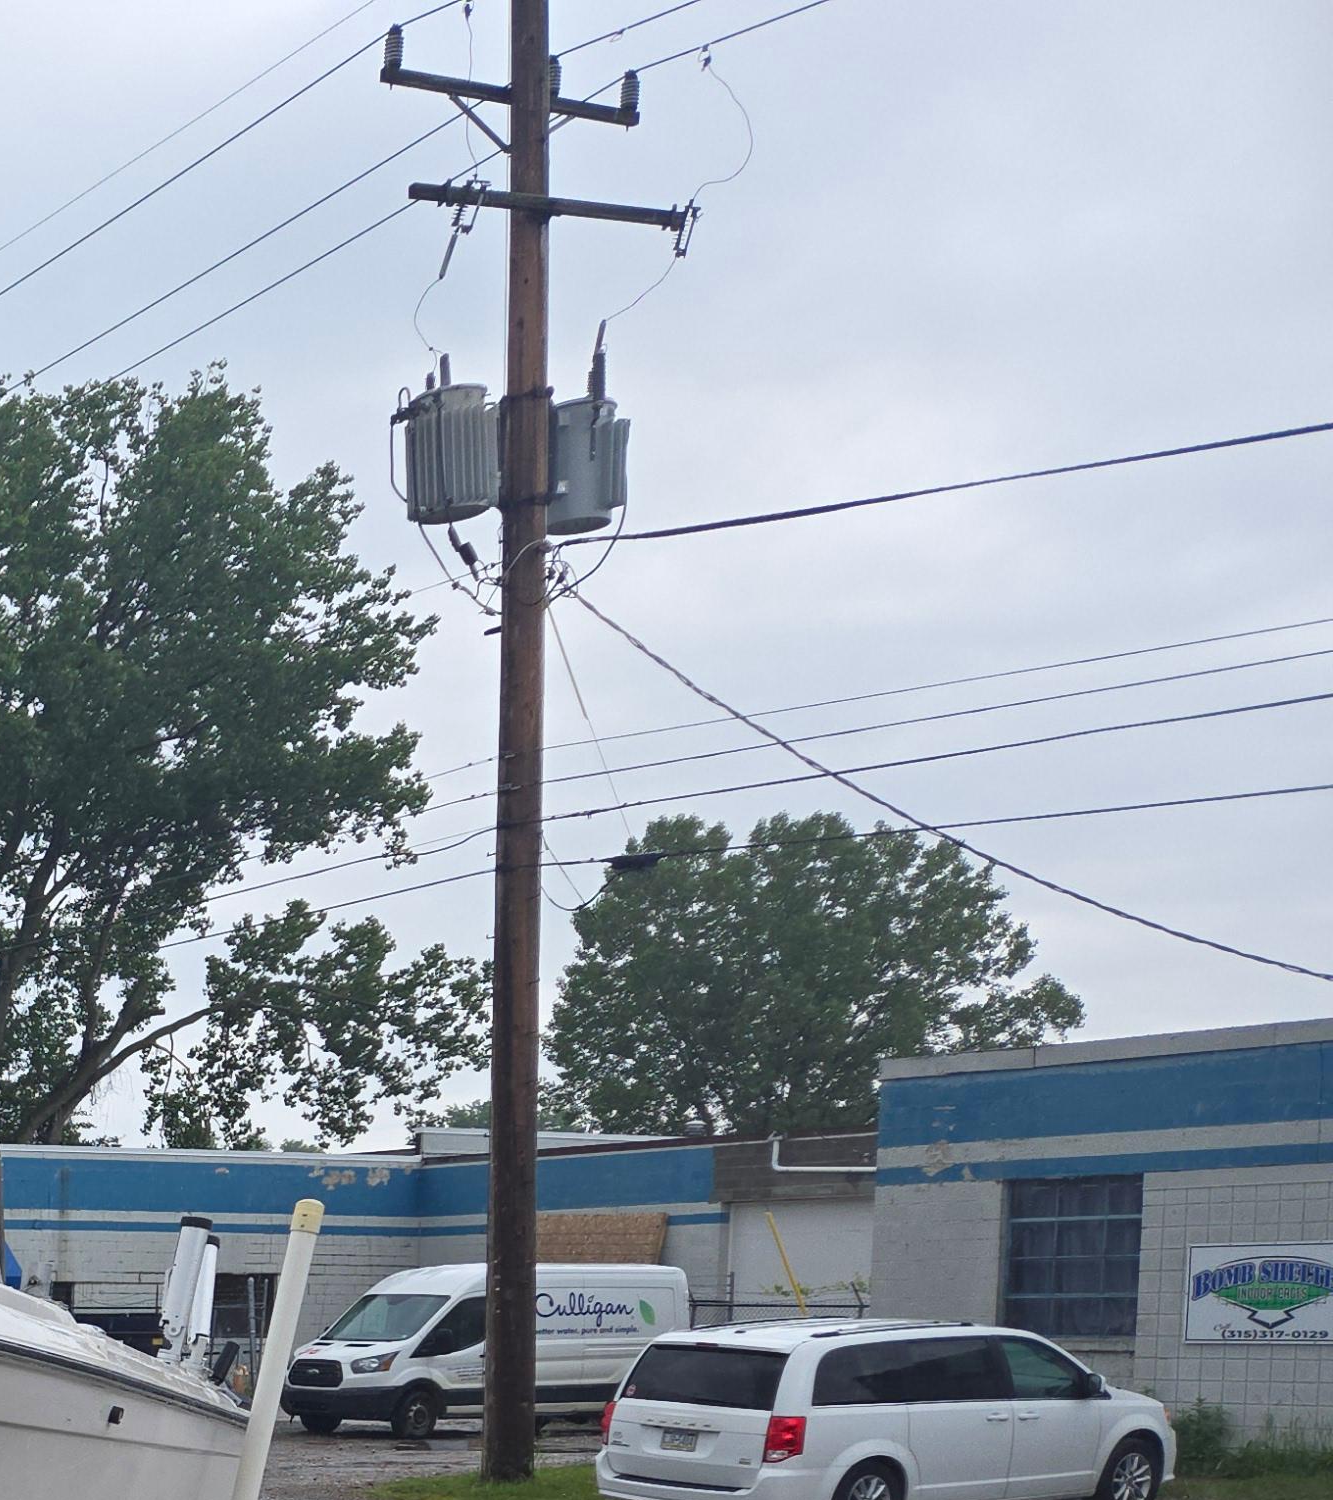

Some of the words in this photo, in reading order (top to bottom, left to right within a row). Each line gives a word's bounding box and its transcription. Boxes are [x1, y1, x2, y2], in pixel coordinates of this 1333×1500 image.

[1193, 1262, 1255, 1300] BOMB
[534, 1292, 634, 1327] Culligan
[1221, 1329, 1329, 1340] (315)317-0129
